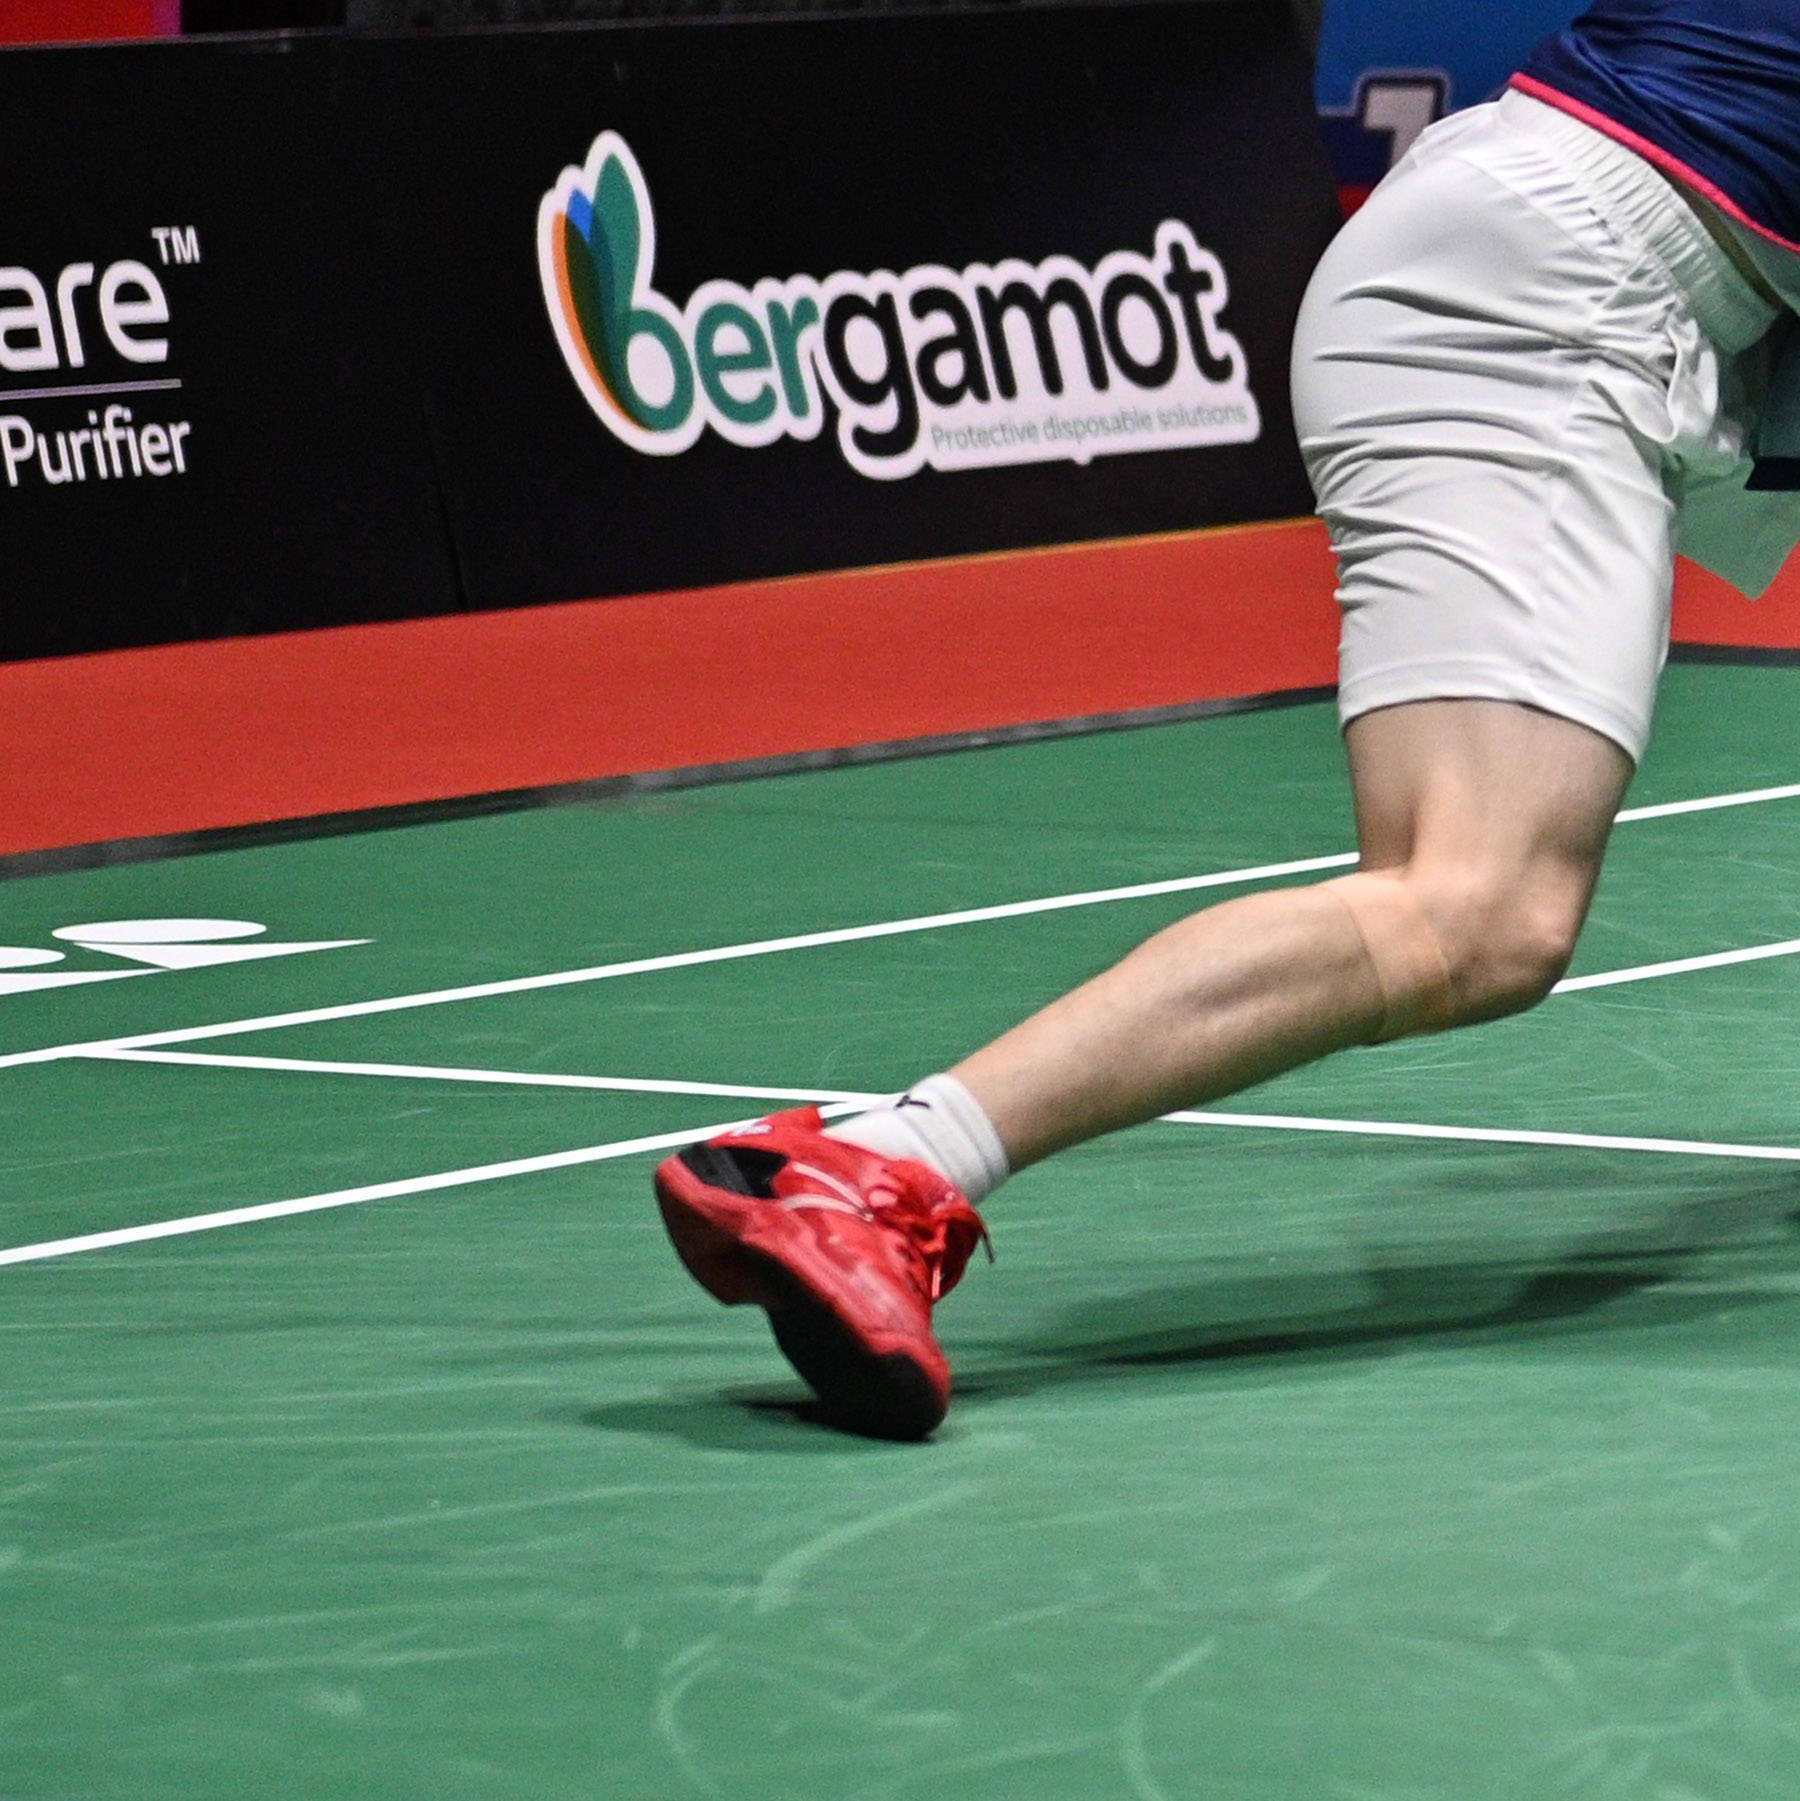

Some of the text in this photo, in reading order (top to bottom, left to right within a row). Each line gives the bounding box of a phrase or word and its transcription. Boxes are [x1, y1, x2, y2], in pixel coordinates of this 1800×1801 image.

[548, 146, 1236, 462] bergamot
[0, 403, 191, 488] Purifier
[930, 401, 1249, 452] Protective disposable solutions
